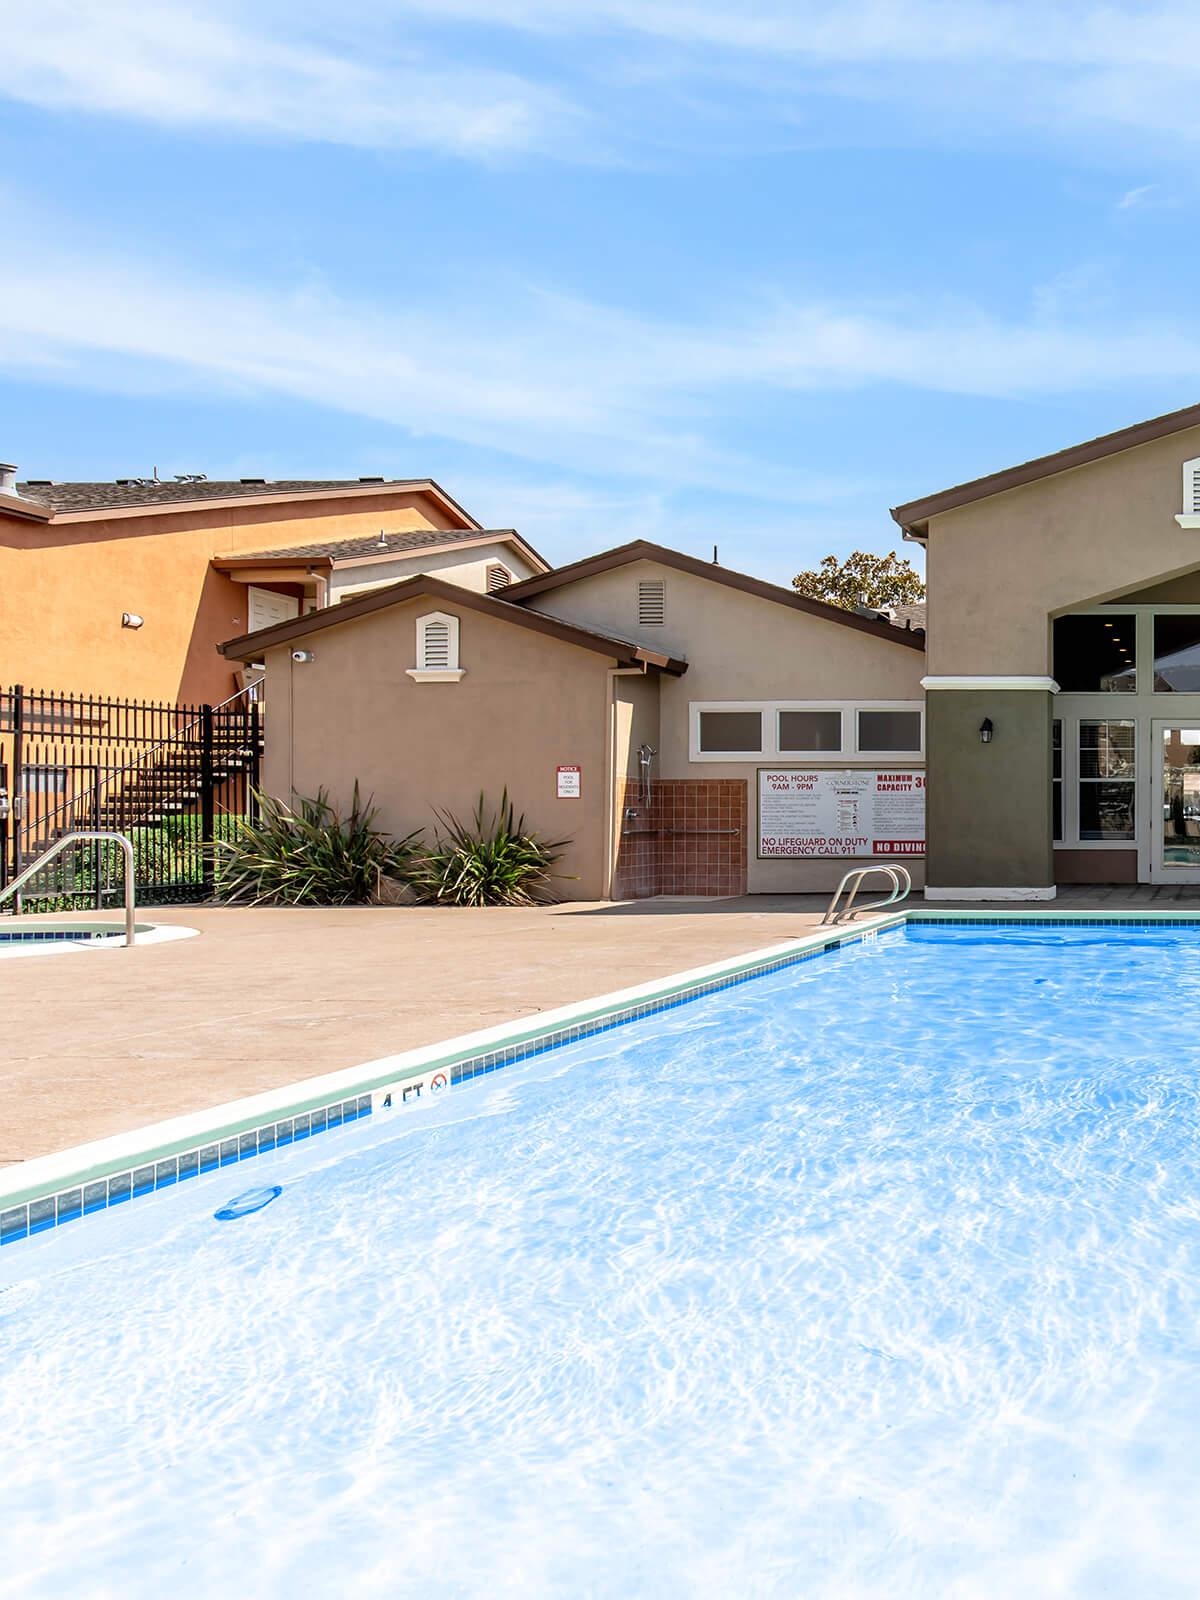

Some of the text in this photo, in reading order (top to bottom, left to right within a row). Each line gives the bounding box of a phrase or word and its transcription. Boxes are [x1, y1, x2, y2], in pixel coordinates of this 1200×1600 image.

[762, 838, 869, 846] NO LIFEGUARD ON DUTY
[762, 847, 856, 855] EMERGENCY CALL 911
[876, 843, 890, 852] NO
[383, 1092, 392, 1107] 4
